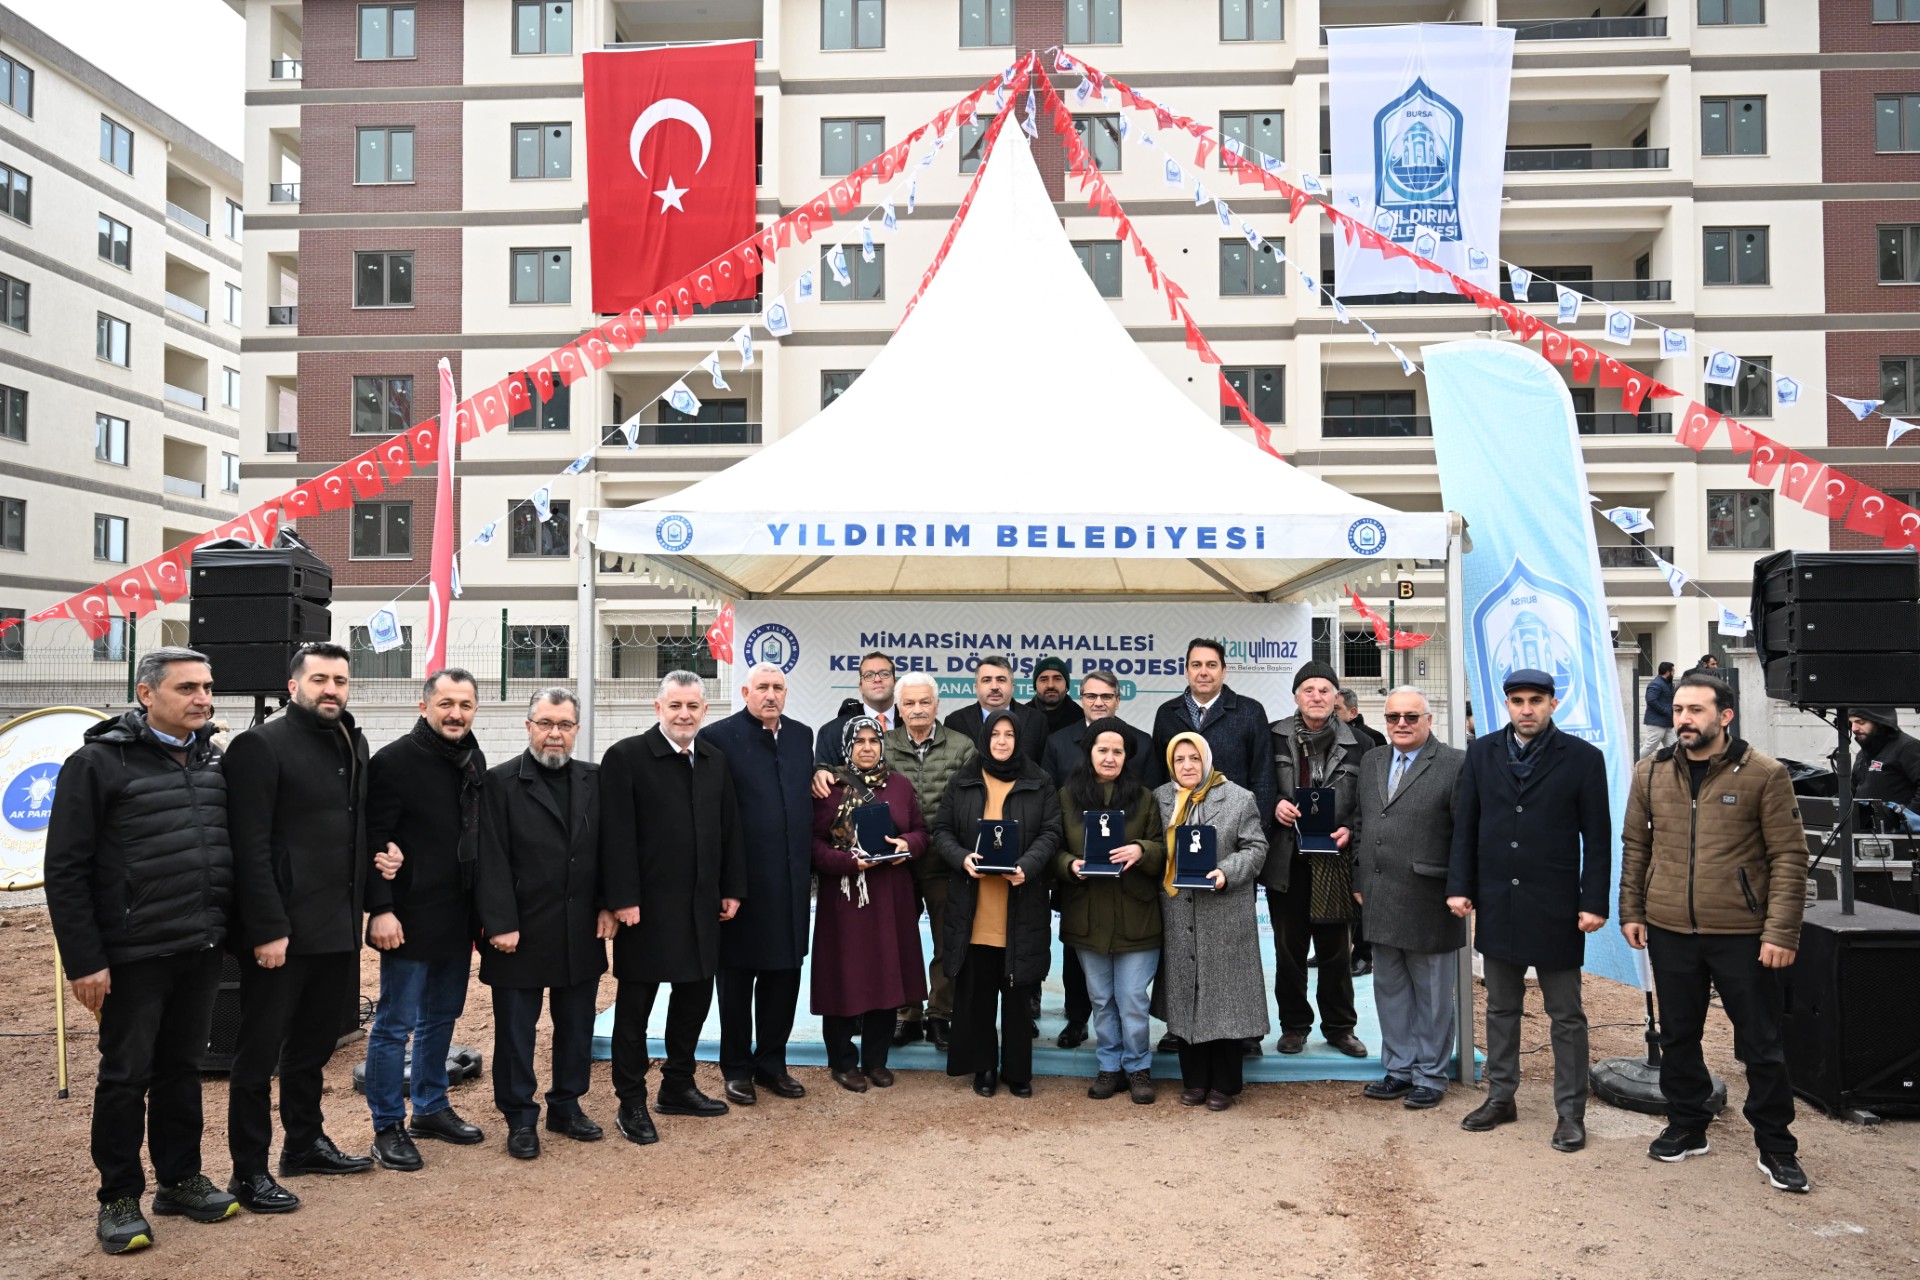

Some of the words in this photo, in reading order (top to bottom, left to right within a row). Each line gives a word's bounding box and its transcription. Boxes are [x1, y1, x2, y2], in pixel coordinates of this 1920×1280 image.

[1390, 208, 1457, 224] ILDIRIM
[767, 523, 970, 547] YILDIRIM
[1400, 582, 1414, 598] B
[1249, 636, 1298, 663] yılmaz
[830, 655, 938, 672] KESEL
[9, 810, 26, 818] AK
